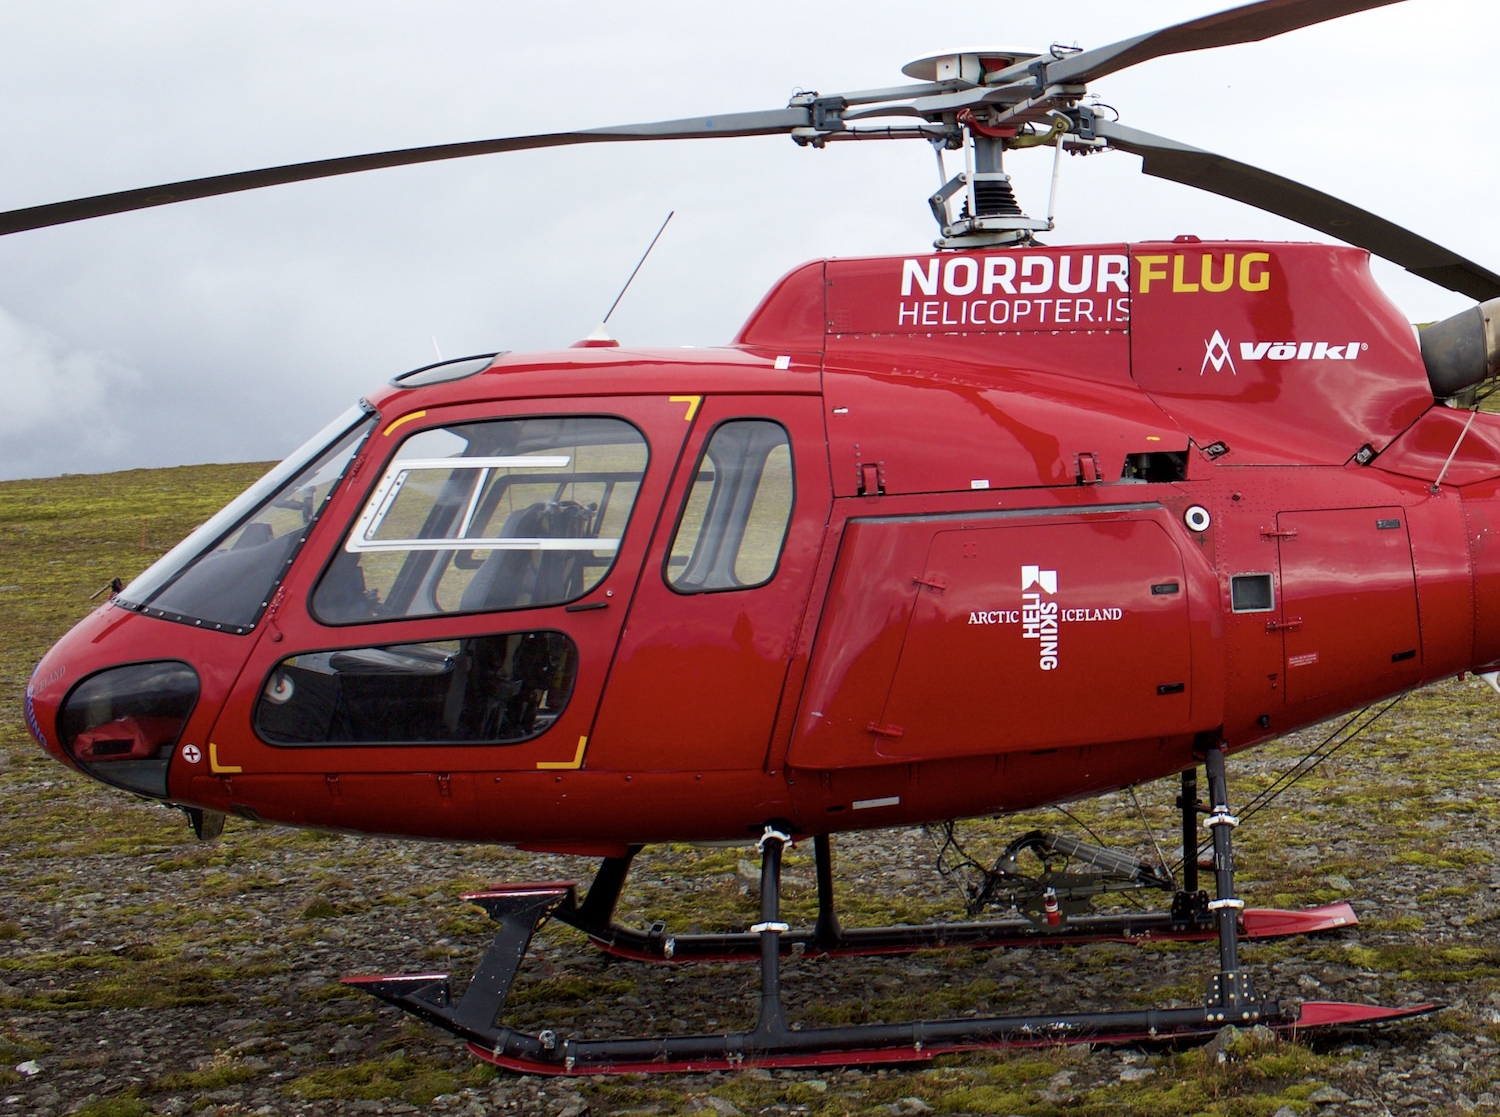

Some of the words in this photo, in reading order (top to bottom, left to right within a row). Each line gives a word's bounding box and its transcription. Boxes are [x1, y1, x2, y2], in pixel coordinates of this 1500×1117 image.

[898, 298, 1133, 326] HELICOPTER.IS
[967, 610, 1020, 625] ARCTIC
[1022, 593, 1041, 639] HELI
[1061, 608, 1123, 622] ICELAND
[1040, 602, 1058, 671] SKIING
